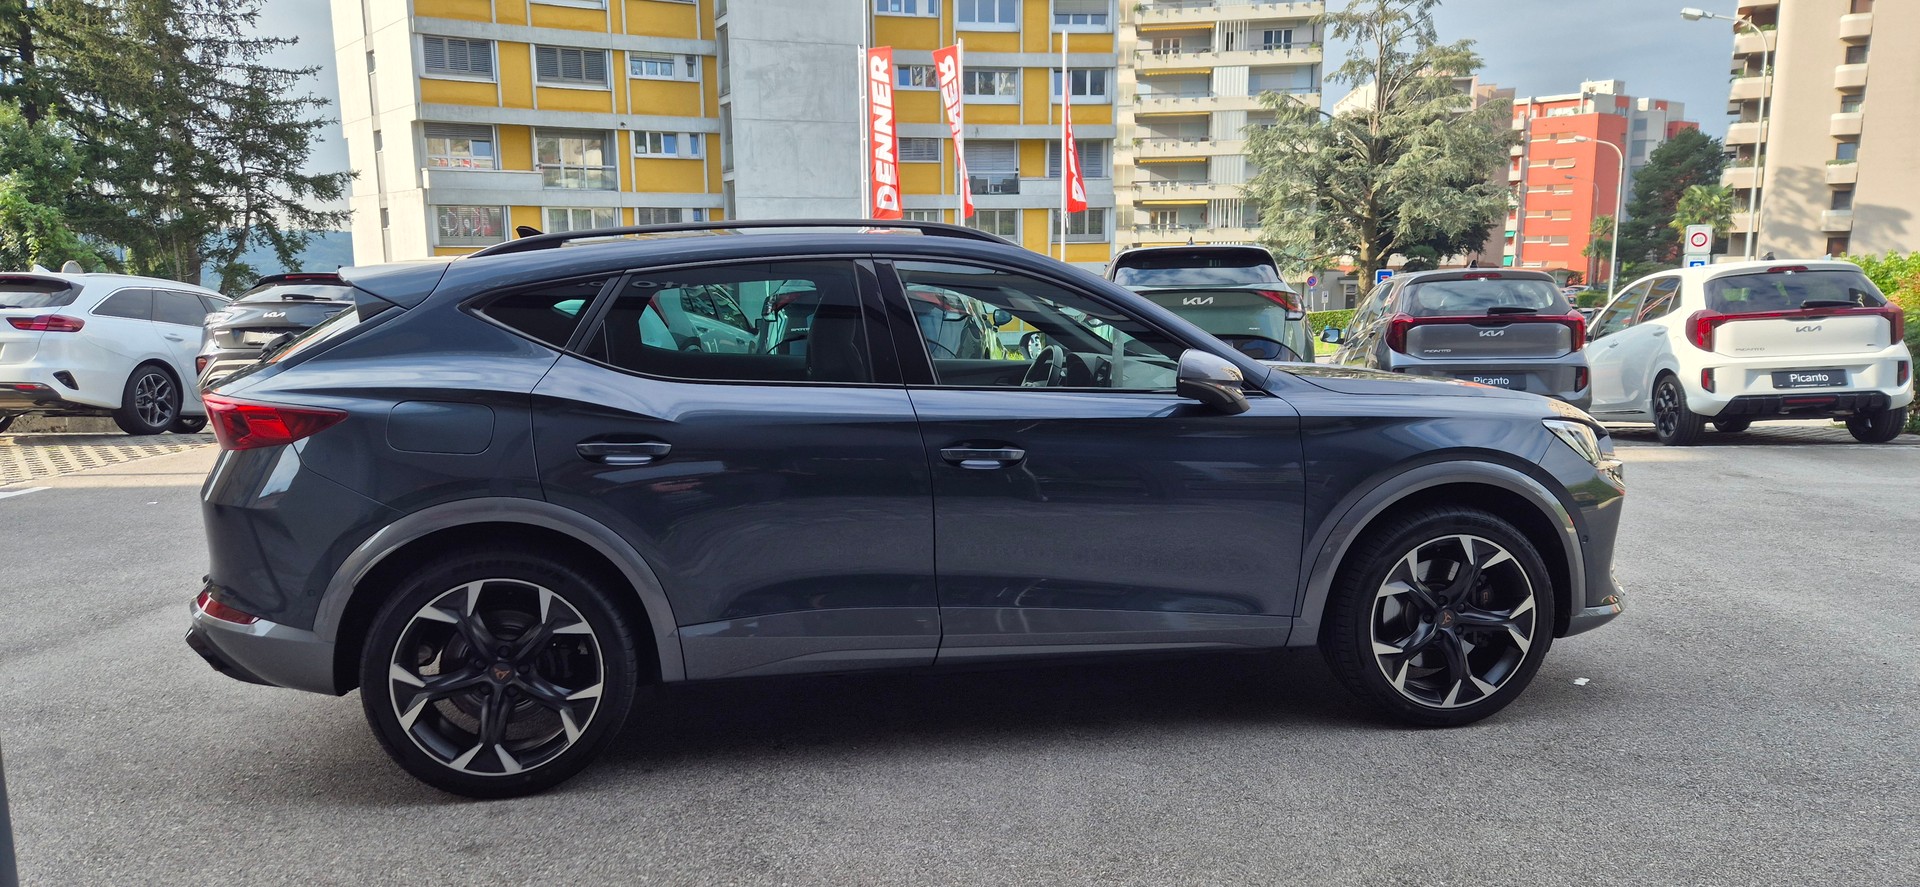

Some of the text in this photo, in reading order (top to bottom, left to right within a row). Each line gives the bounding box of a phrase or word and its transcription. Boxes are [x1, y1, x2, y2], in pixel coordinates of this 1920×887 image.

[870, 55, 899, 212] DENNER
[1182, 296, 1214, 305] KIA
[1795, 325, 1822, 333] KIA
[1473, 376, 1510, 385] Picanto
[1789, 373, 1829, 383] Picanto
